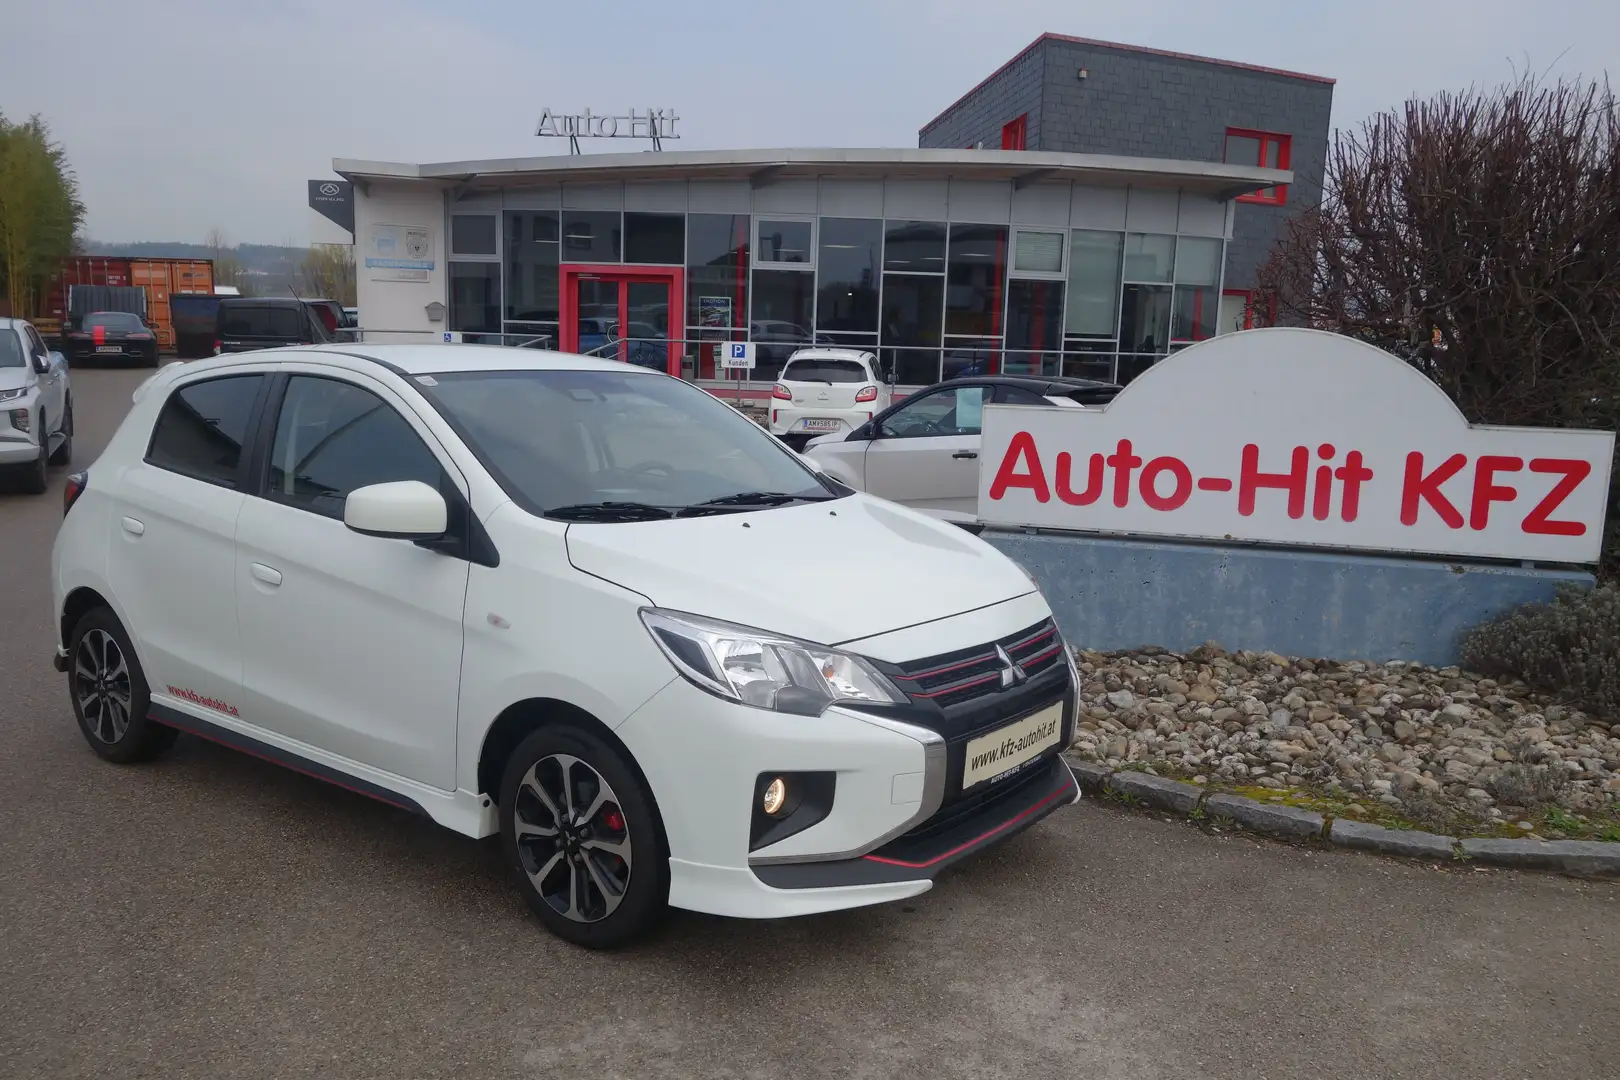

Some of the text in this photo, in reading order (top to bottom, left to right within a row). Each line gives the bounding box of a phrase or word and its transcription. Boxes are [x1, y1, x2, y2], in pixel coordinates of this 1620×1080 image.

[535, 107, 681, 138] Auto Hit
[734, 345, 743, 357] P
[989, 431, 1592, 537] Auto-Hit KFZ
[971, 718, 1056, 771] www.kfz-autohit.at
